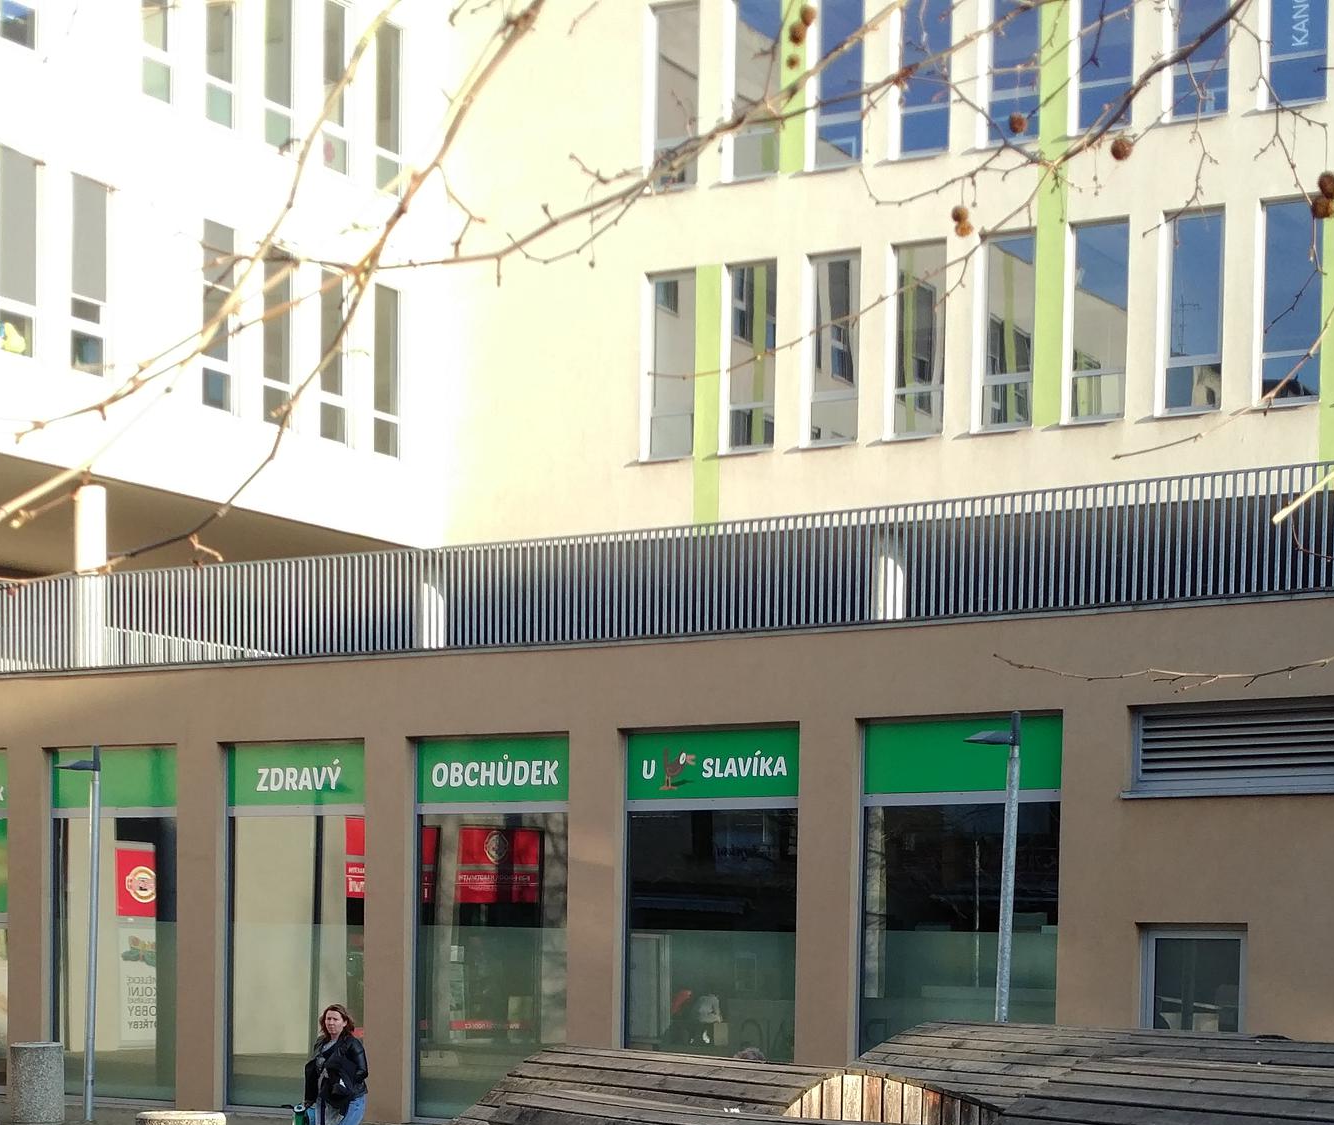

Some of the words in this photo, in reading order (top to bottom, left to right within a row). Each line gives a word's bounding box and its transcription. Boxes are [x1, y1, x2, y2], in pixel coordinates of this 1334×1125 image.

[1292, 0, 1309, 46] KAN
[256, 758, 342, 792] ZDRAVÝ
[432, 754, 559, 788] OBCHŮDEK
[642, 759, 656, 780] U
[702, 750, 788, 778] SLAVÍKA
